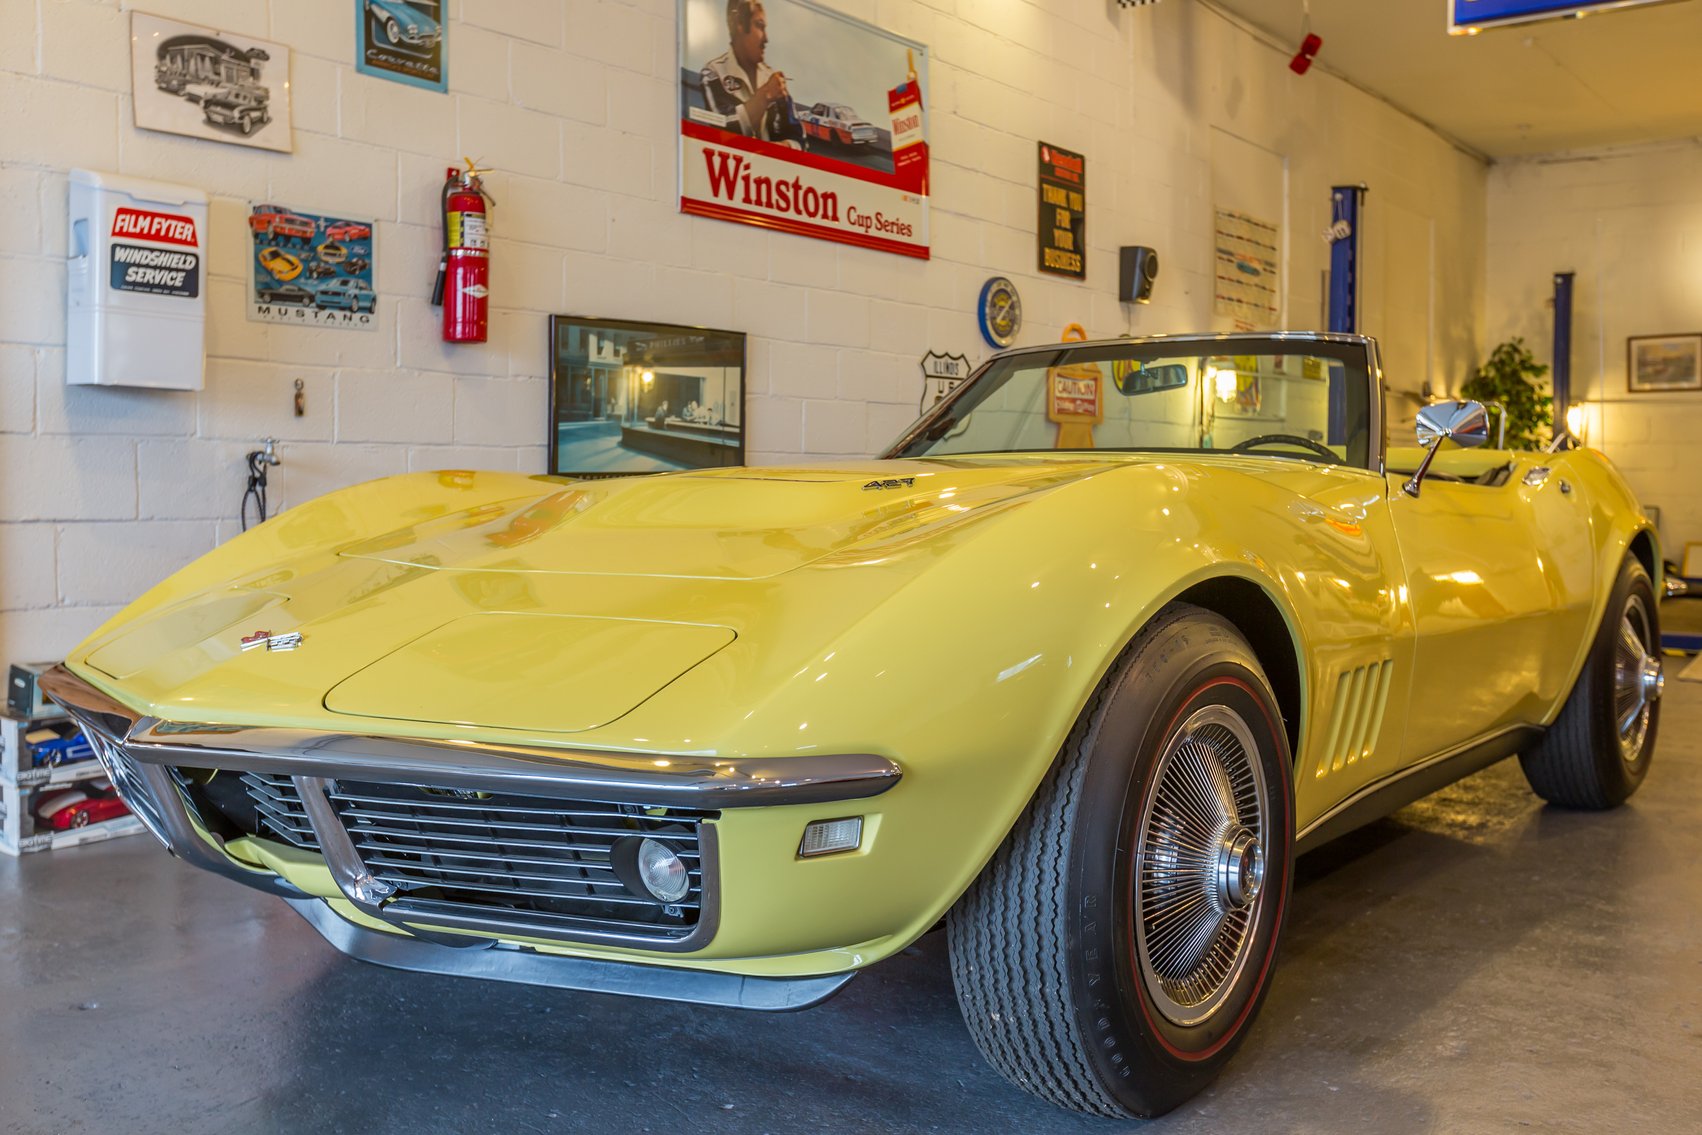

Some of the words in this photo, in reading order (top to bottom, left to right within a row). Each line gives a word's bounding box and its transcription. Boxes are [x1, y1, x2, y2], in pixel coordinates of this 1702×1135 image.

[703, 147, 840, 222] Winston
[847, 206, 873, 233] Cup
[875, 212, 913, 238] Series
[115, 214, 152, 234] FILM
[150, 217, 194, 242] FYTER
[114, 246, 197, 270] WINDSHIELD
[125, 266, 186, 287] SERVICE
[257, 306, 370, 323] MUSTANG
[862, 478, 915, 491] 427
